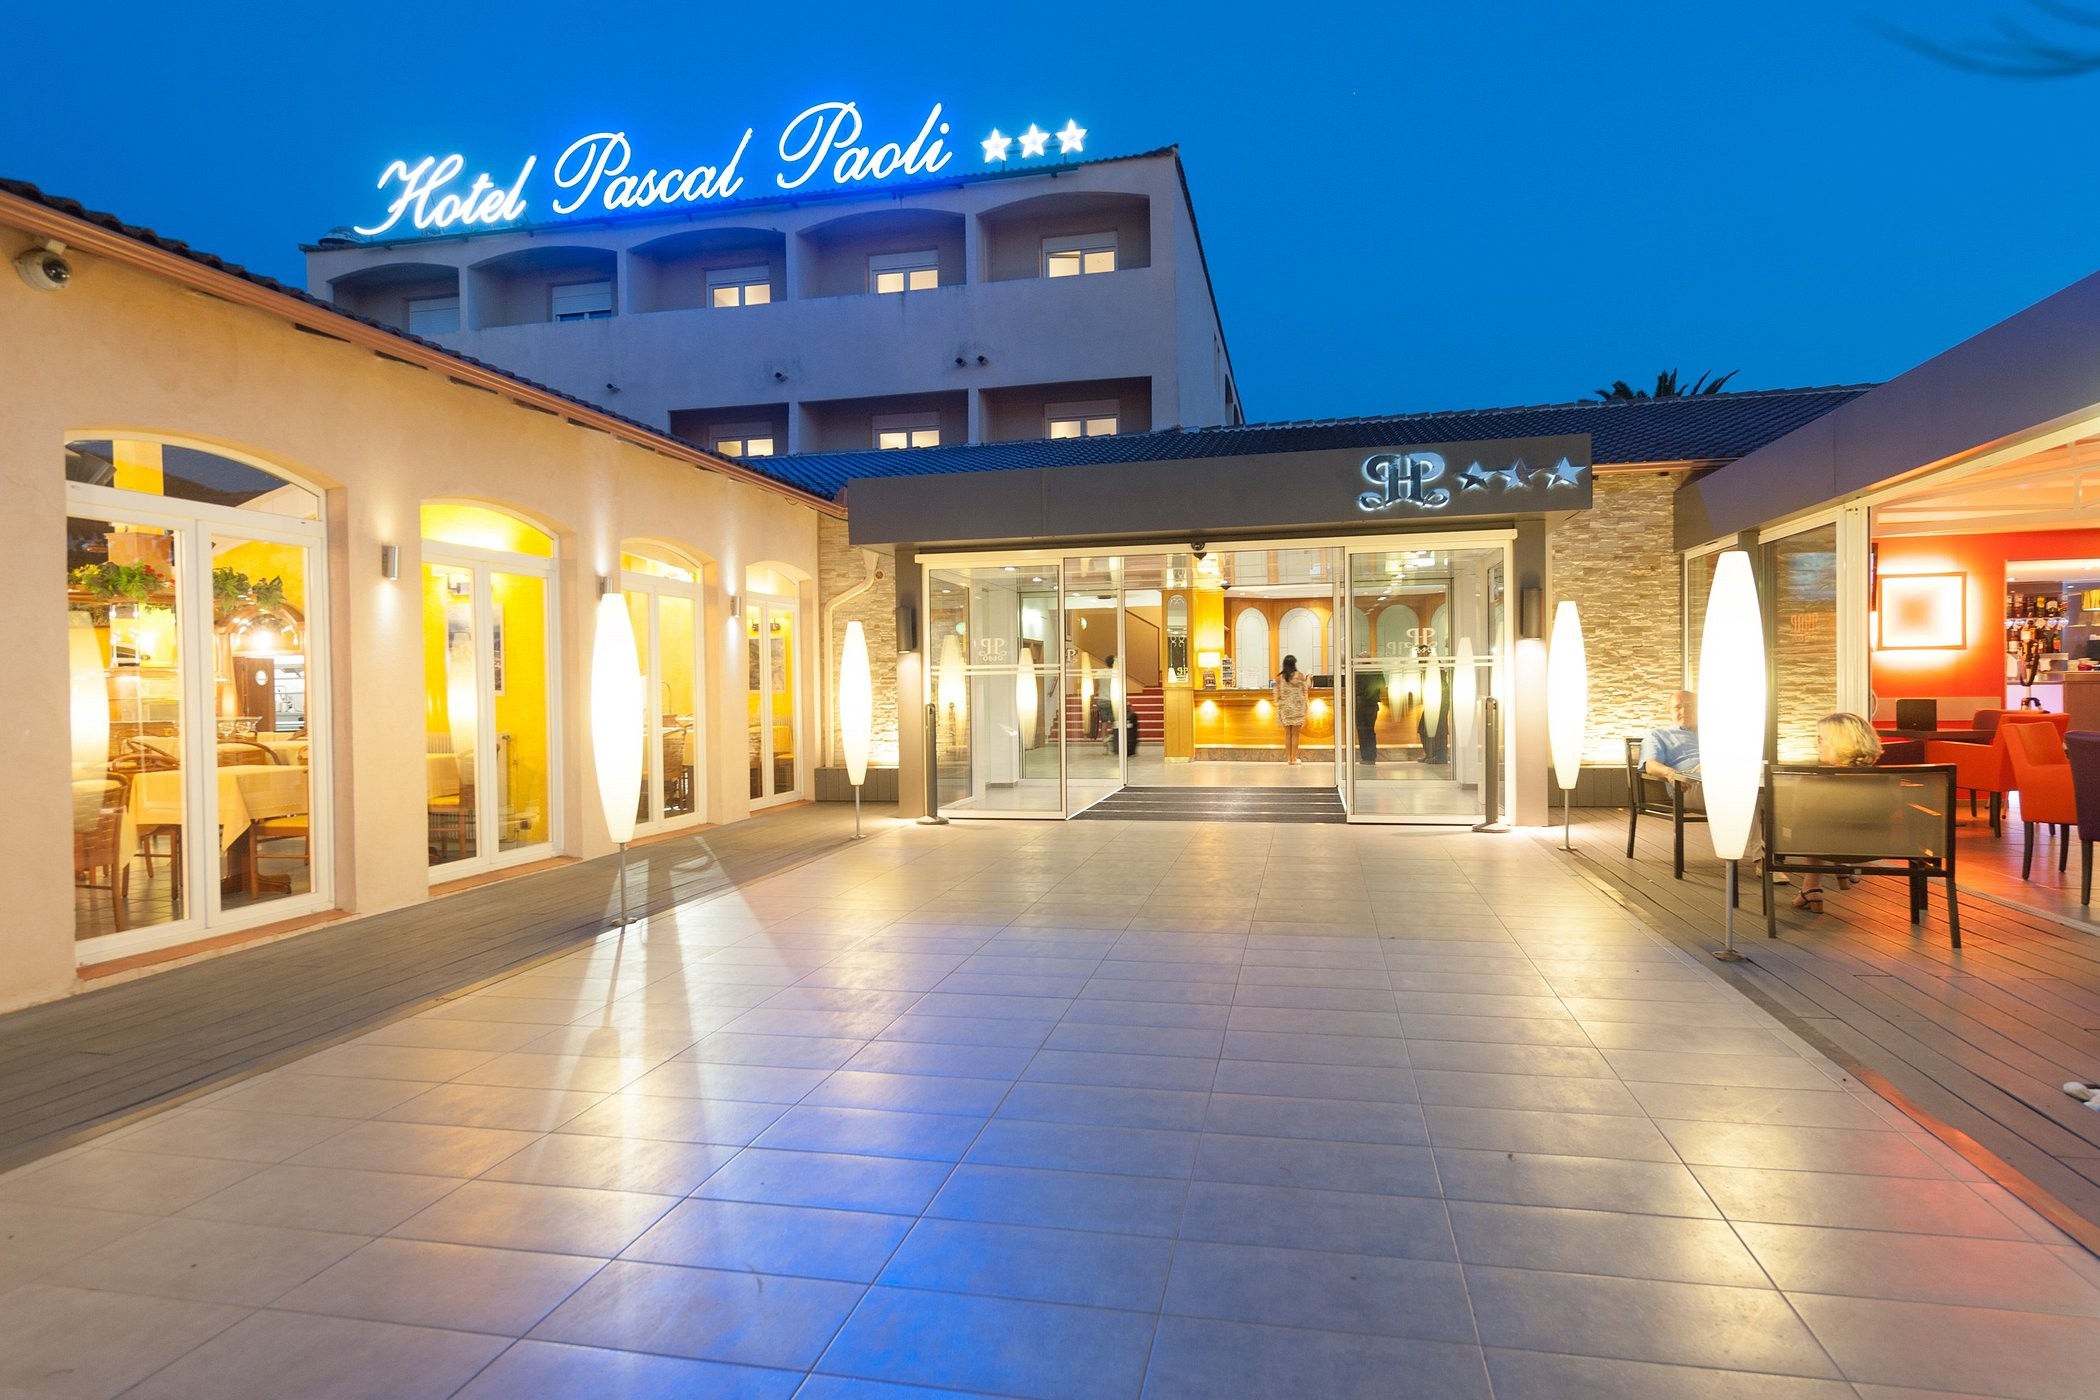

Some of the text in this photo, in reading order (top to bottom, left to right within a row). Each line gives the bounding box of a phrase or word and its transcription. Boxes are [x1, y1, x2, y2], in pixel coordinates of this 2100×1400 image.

[353, 101, 953, 236] Hotel Pascal Paoli
